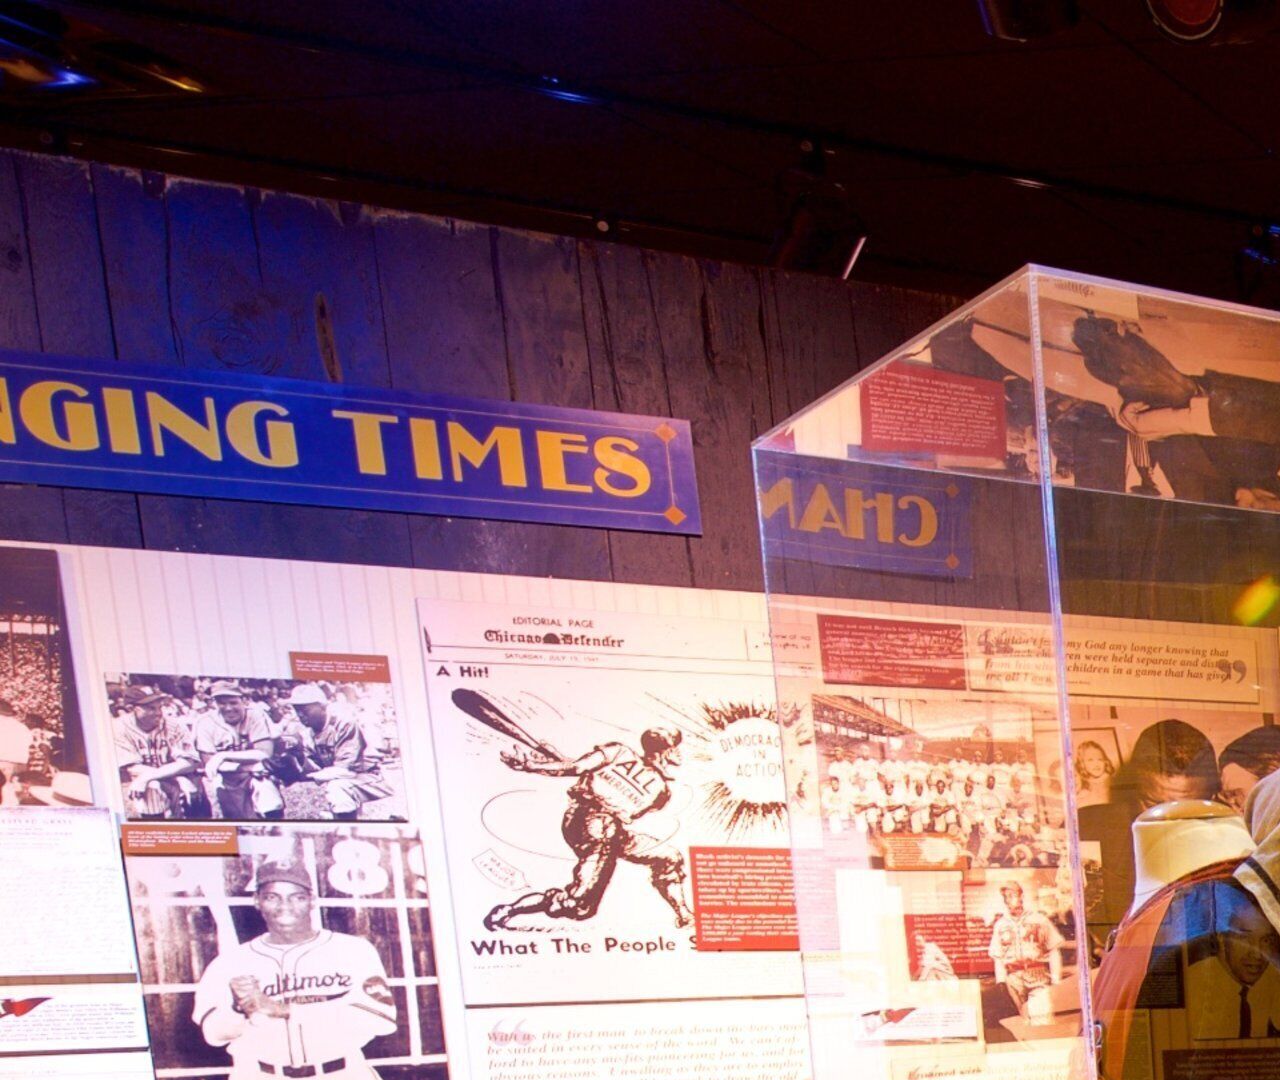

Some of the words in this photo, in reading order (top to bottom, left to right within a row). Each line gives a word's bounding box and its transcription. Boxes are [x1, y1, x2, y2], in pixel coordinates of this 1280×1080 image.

[0, 377, 299, 468] GING
[332, 409, 651, 498] TIMES
[512, 617, 562, 627] EDITORIAL
[568, 619, 594, 629] PAGE
[484, 629, 542, 644] Chicago
[560, 632, 624, 648] Defender
[1067, 640, 1082, 651] my
[1085, 639, 1107, 650] God
[1109, 642, 1128, 653] any
[1131, 642, 1163, 655] longer
[1165, 644, 1208, 658] knowing
[1210, 648, 1229, 657] that
[1085, 653, 1109, 662] were
[1112, 652, 1133, 664] held
[1136, 655, 1177, 668] separate
[1180, 657, 1199, 667] and
[436, 665, 450, 677] A
[459, 666, 489, 679] Hit!
[1067, 663, 1110, 675] children
[1135, 668, 1161, 680] game
[1164, 668, 1184, 678] that
[1186, 669, 1204, 679] has
[719, 735, 781, 753] DEMOCRAC
[753, 750, 767, 760] IN
[616, 760, 656, 795] ALL
[471, 939, 539, 956] What
[551, 938, 592, 954] The
[604, 935, 676, 956] People
[263, 972, 352, 997] altimore
